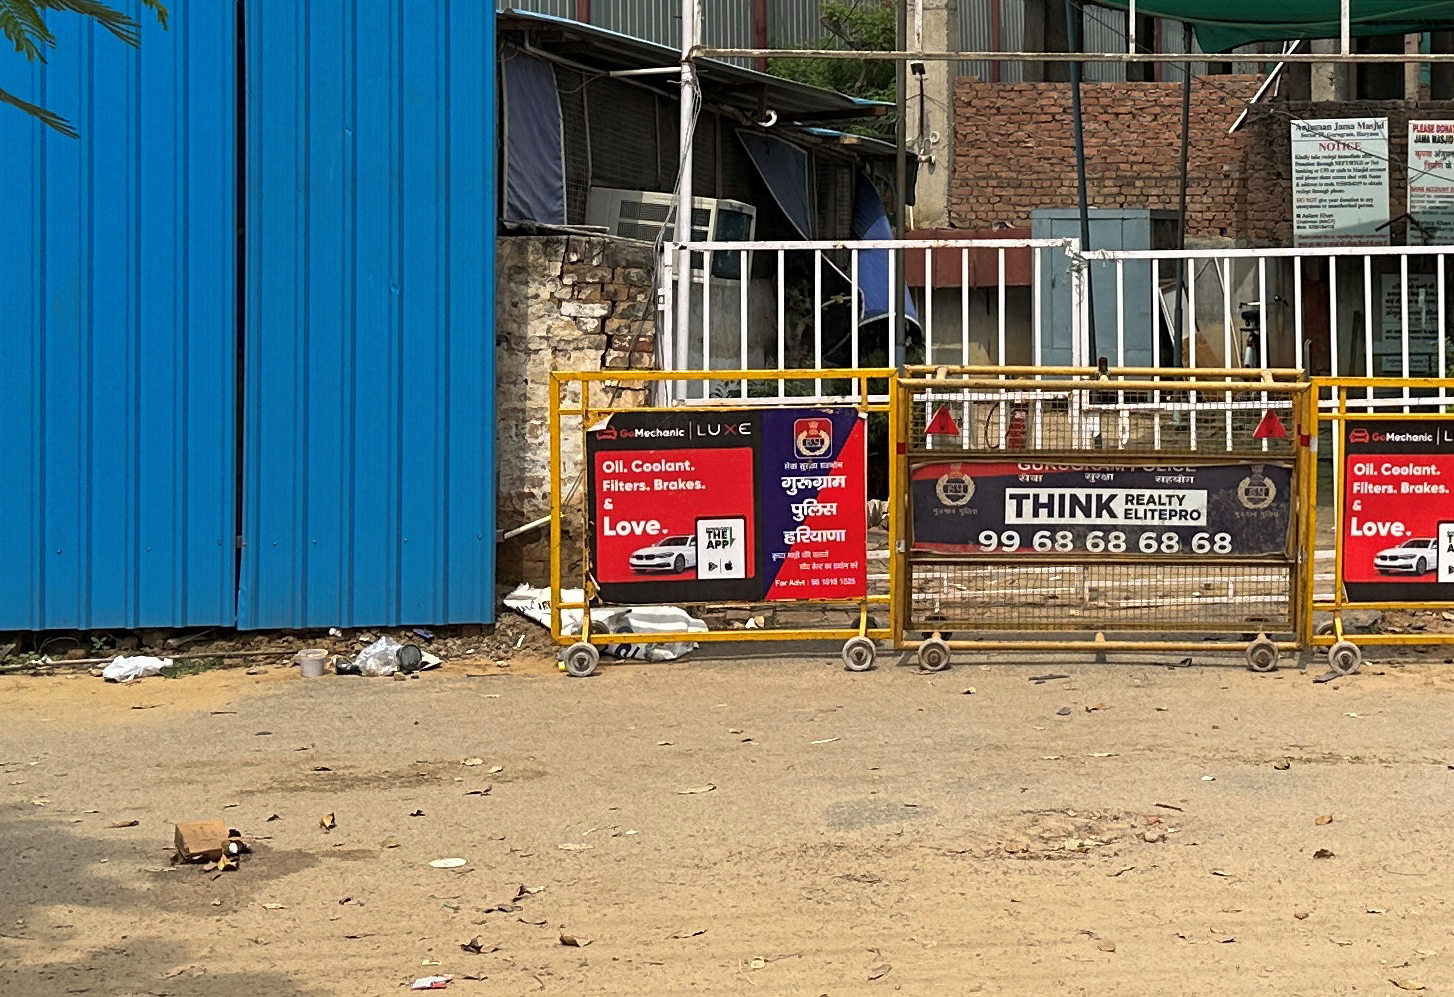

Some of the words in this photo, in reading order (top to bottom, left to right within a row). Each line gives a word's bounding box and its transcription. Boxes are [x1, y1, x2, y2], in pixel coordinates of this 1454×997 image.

[1334, 122, 1355, 131] Jama
[1357, 121, 1384, 131] Masjid
[1413, 123, 1435, 134] PLEASE
[1414, 135, 1431, 143] JAMA
[1432, 135, 1454, 144] MASJID
[1319, 142, 1362, 152] NOTICE
[620, 428, 685, 438] GoMechanic
[697, 422, 752, 436] LUXE
[1372, 432, 1433, 442] GoMechanic
[602, 460, 628, 473] Oil.
[631, 459, 696, 473] Coolant.
[1353, 463, 1378, 476] Oil.
[1380, 463, 1441, 476] Coolant.
[1084, 472, 1114, 483] सुरक्षा
[1155, 474, 1195, 484] सहयोग
[602, 479, 651, 492] Filters.
[653, 478, 706, 491] Brakes.
[1352, 482, 1398, 494] Filters.
[1400, 482, 1450, 494] Brakes.
[603, 498, 614, 510] &
[790, 498, 838, 522] पुलिस
[1008, 493, 1119, 519] THINK
[1125, 494, 1187, 507] REALTY
[1352, 500, 1362, 511] &
[1124, 508, 1201, 521] ELITEPRO
[706, 531, 728, 540] THE
[782, 525, 847, 545] हरियाणा
[706, 540, 729, 549] APP
[978, 530, 1021, 552] 99
[1032, 530, 1073, 553] 68
[1085, 530, 1127, 553] 68
[1138, 531, 1180, 554] 68
[1191, 532, 1233, 554] 68
[775, 579, 788, 587] For
